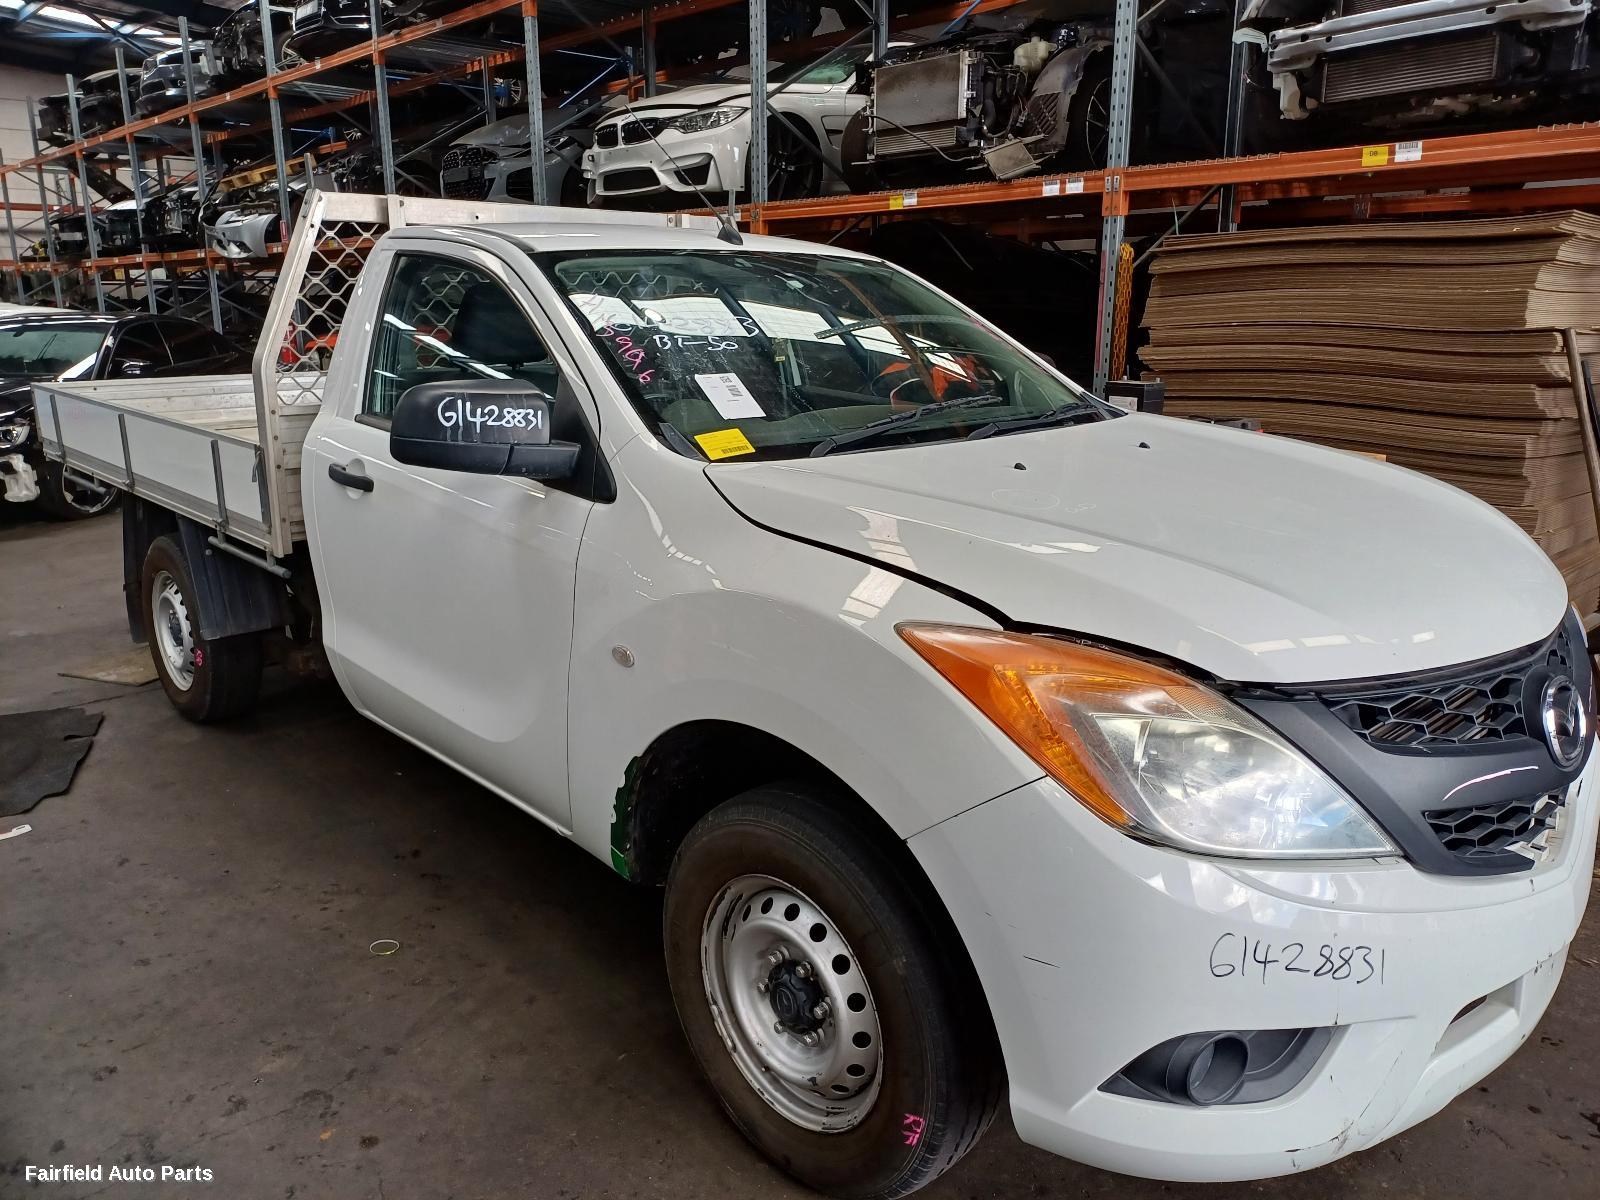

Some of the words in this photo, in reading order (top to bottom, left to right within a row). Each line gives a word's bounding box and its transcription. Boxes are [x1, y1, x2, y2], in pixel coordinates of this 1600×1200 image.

[652, 334, 739, 351] BT-50
[437, 396, 542, 433] 61428831
[1209, 932, 1385, 985] 61428831
